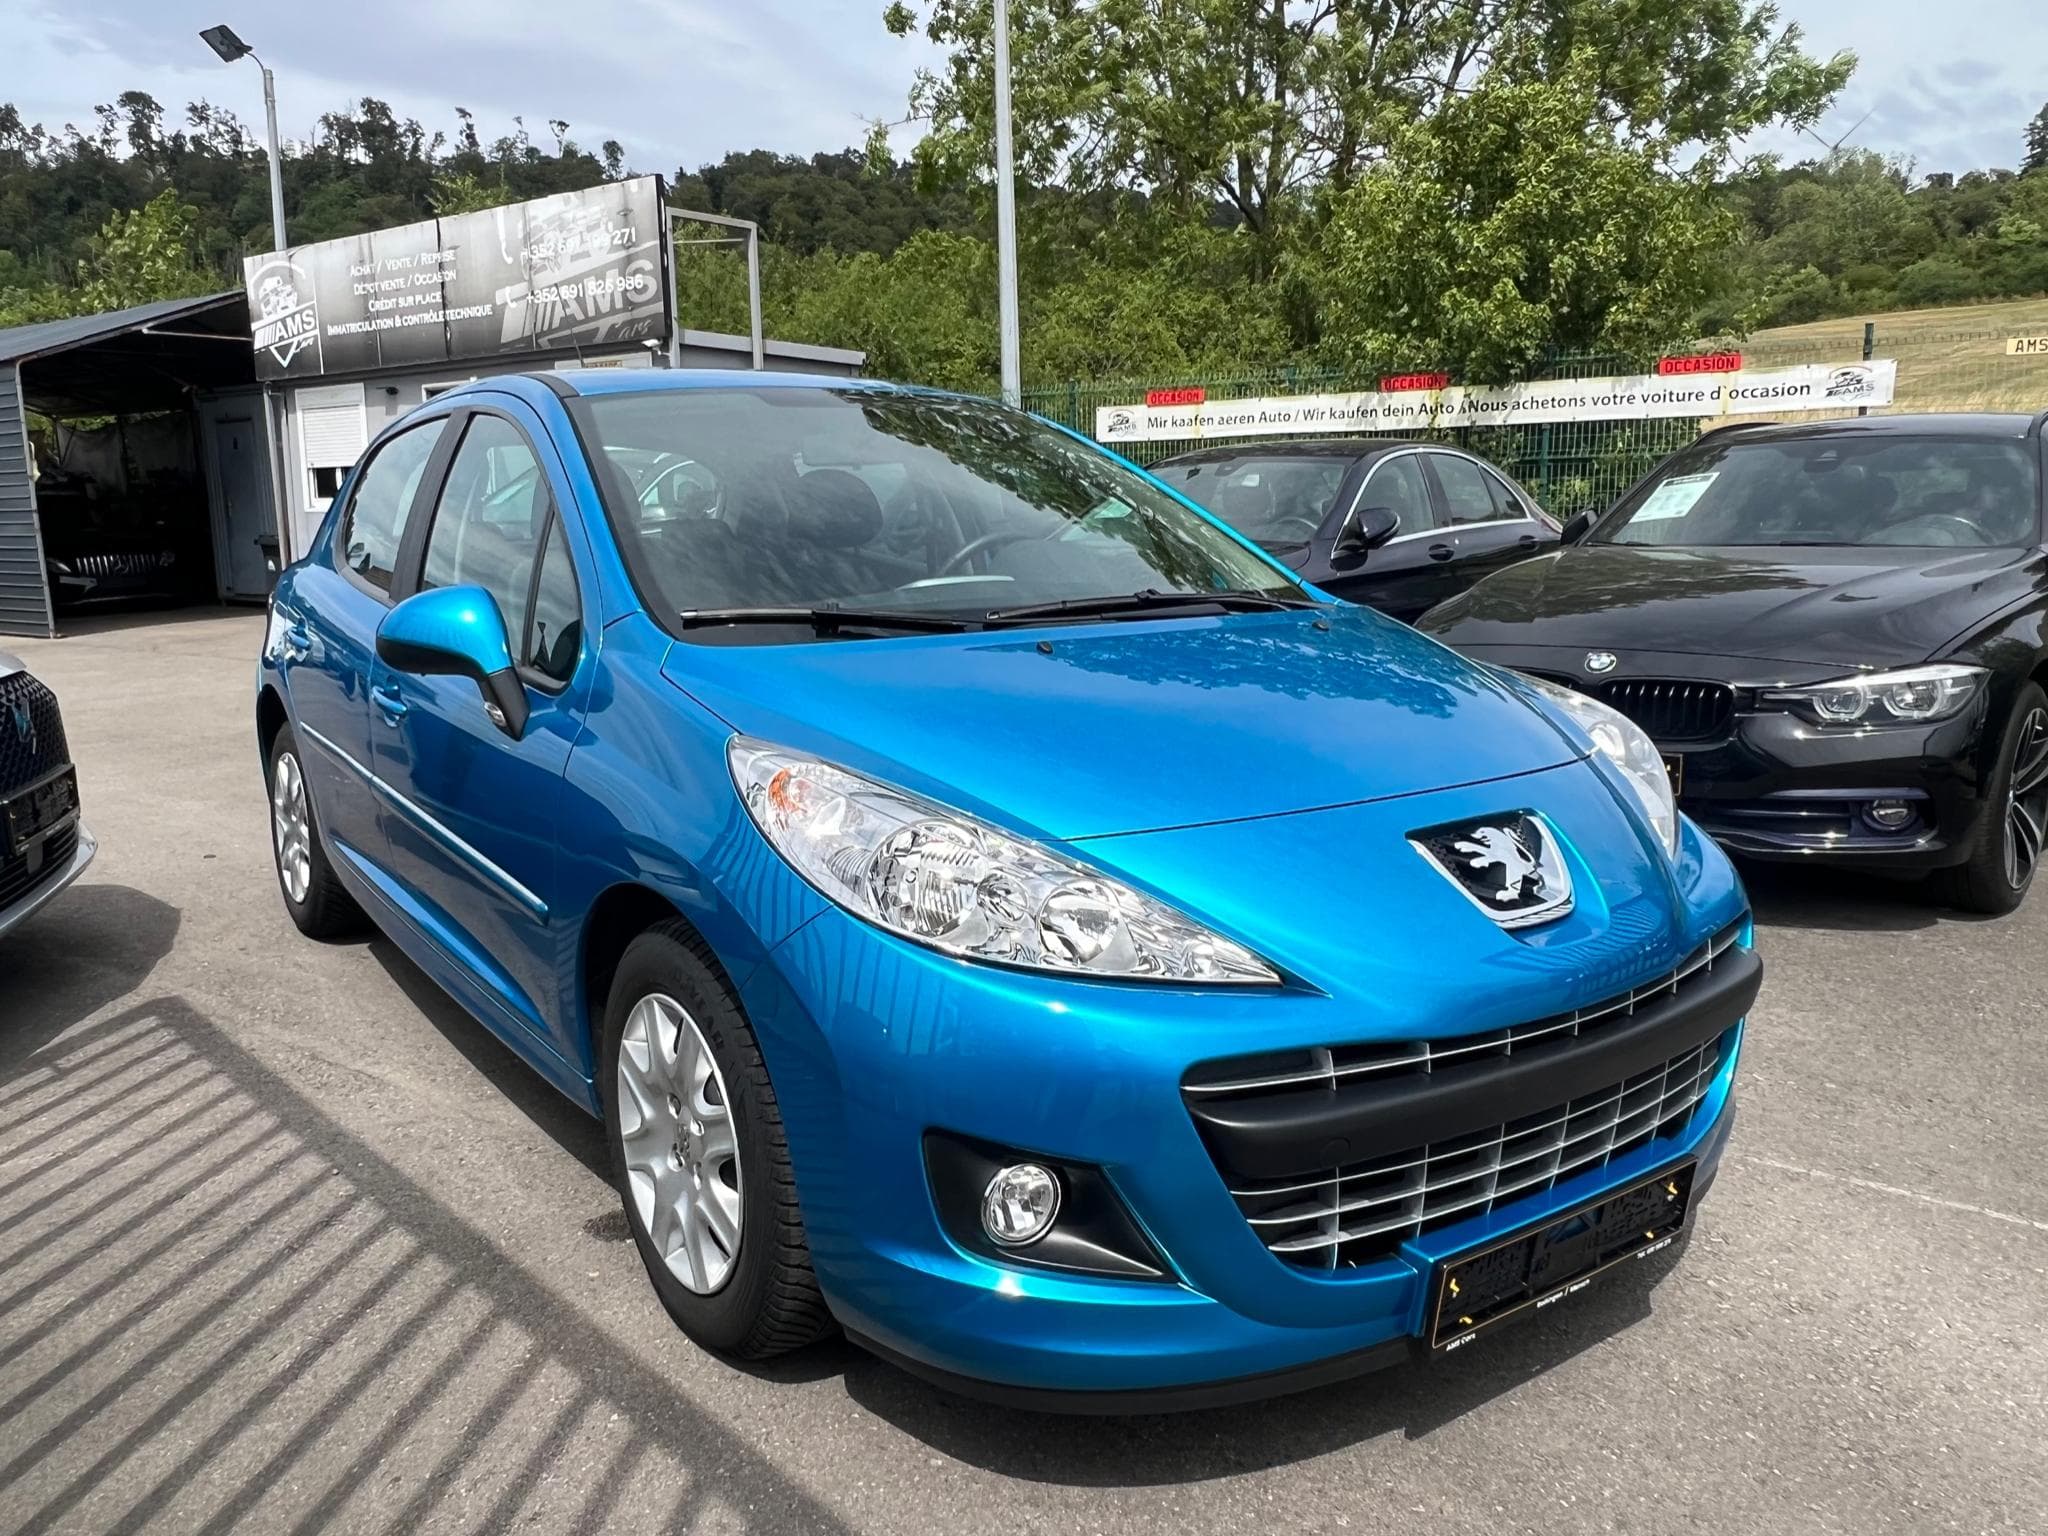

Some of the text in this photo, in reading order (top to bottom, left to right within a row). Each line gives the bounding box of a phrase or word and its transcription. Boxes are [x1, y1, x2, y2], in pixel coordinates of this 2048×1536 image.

[275, 308, 316, 342] AMS
[1664, 356, 1735, 375] OCCASION
[1384, 376, 1443, 391] OCCASION
[1150, 391, 1199, 404] OCCASION
[1147, 416, 1167, 429] Mir
[1171, 413, 1214, 428] kaafen
[1217, 412, 1254, 426] aeren
[1258, 409, 1291, 424] Auto
[1302, 406, 1326, 421] Wir
[1329, 403, 1378, 419] kaufen
[1382, 403, 1414, 417] dein
[1419, 401, 1454, 416] Auto
[1468, 399, 1508, 413] Nous
[1511, 392, 1587, 411] achetons
[1591, 393, 1637, 407] votre
[1640, 387, 1705, 404] voiture
